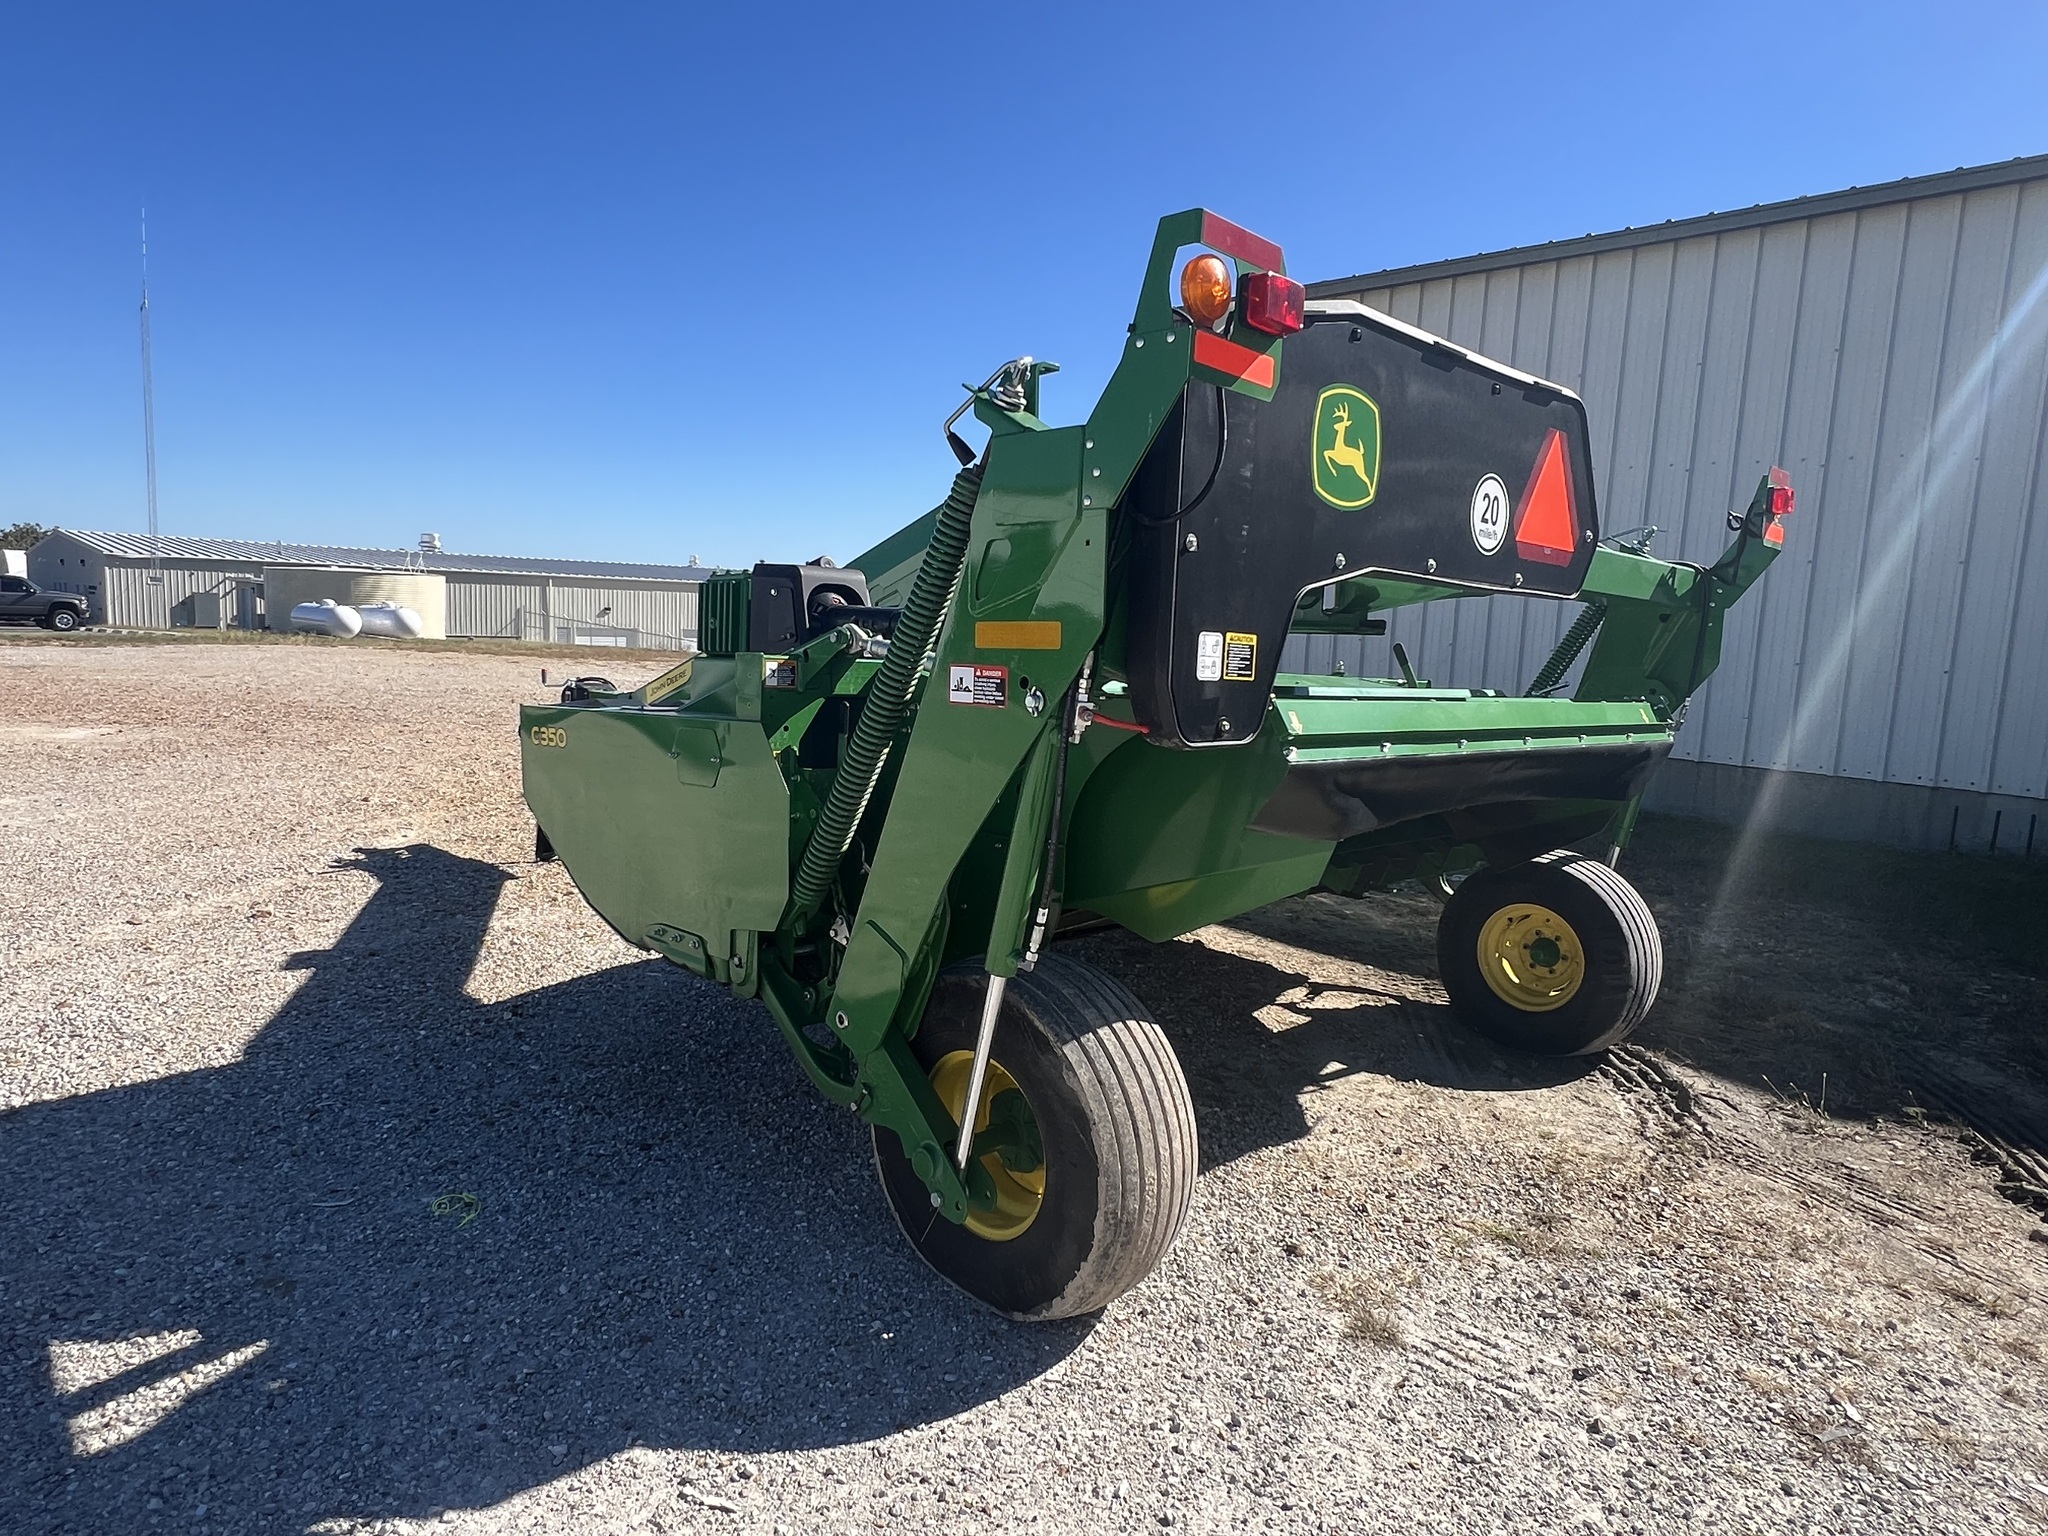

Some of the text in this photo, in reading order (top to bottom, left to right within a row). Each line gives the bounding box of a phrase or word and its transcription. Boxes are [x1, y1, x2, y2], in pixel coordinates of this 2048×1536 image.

[1480, 492, 1500, 526] 20
[1233, 635, 1254, 643] CAUTION
[650, 669, 688, 697] JOHN DEERE
[530, 726, 567, 748] C350
